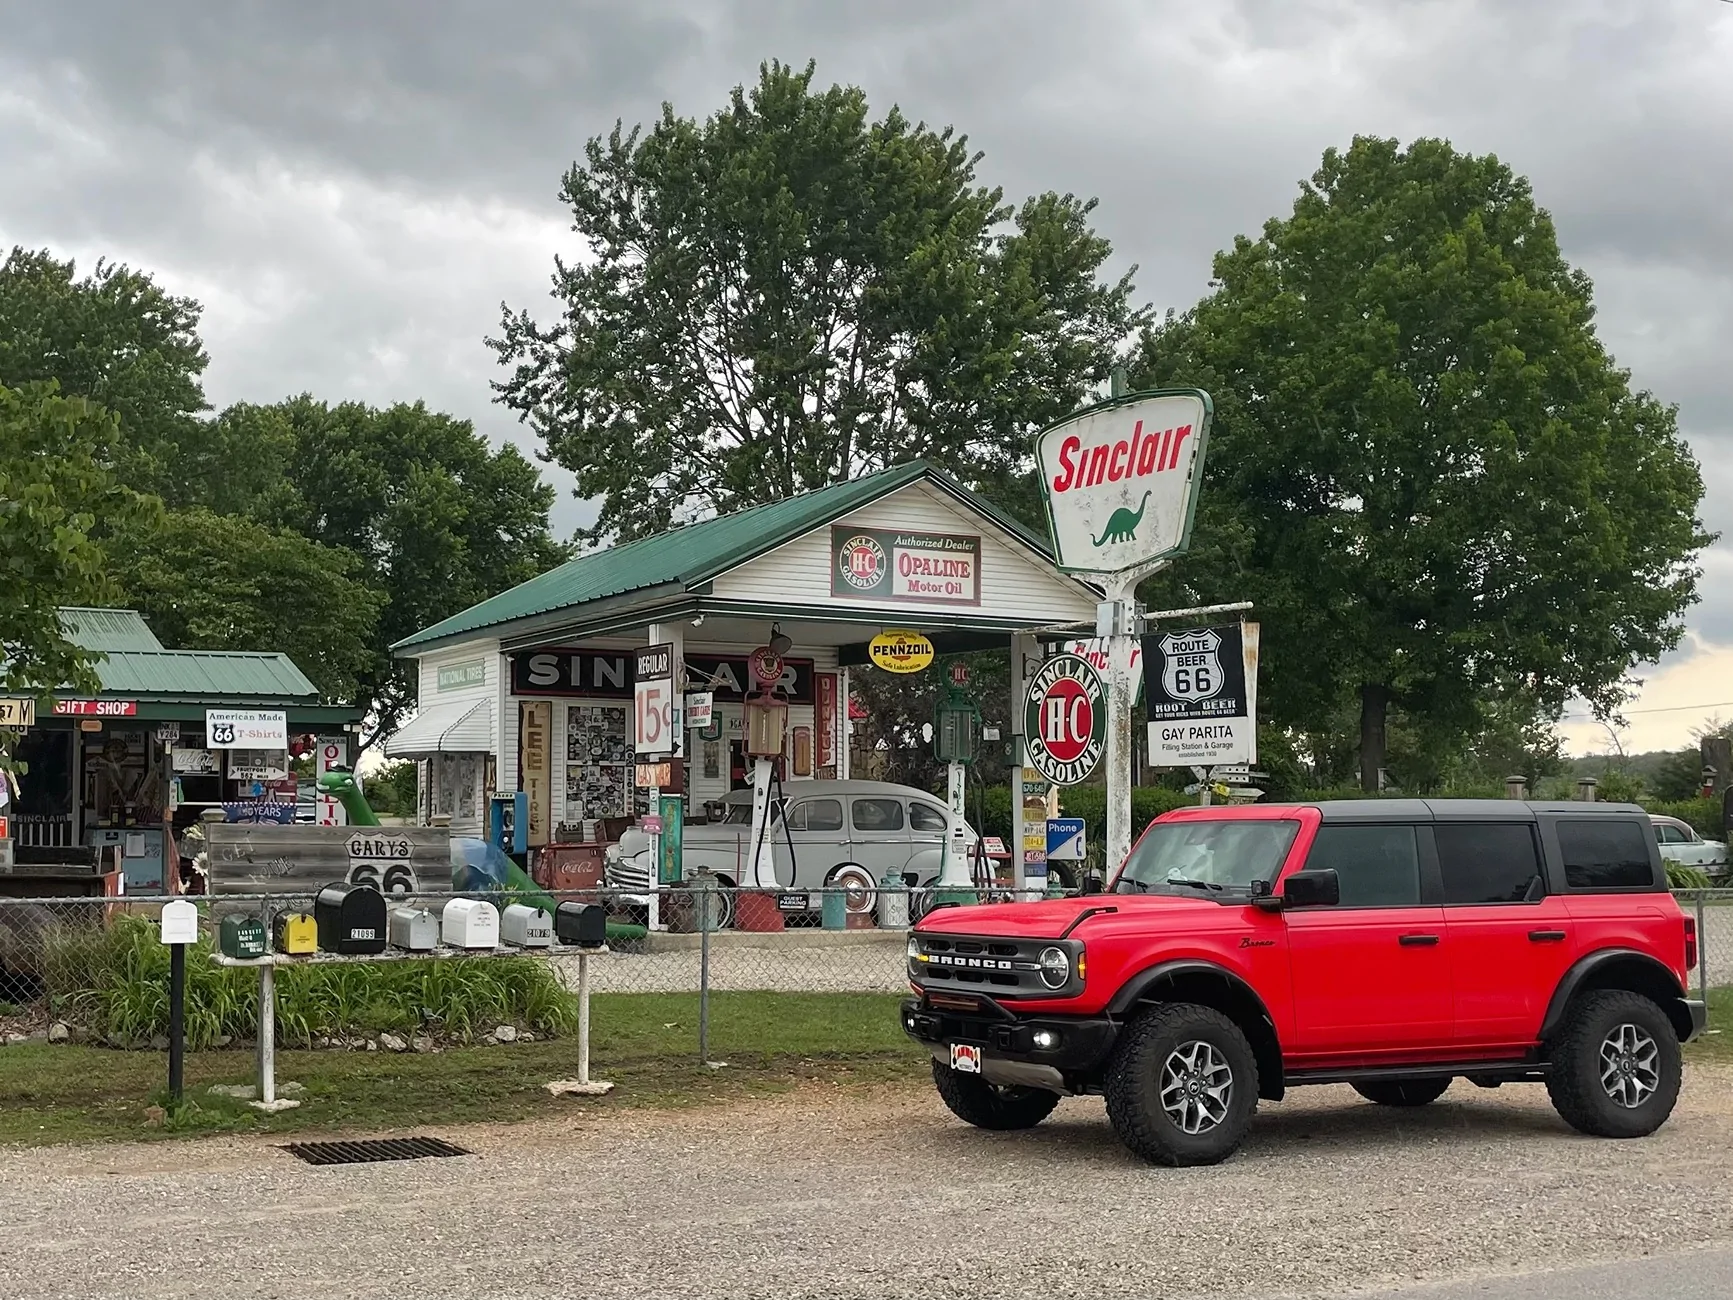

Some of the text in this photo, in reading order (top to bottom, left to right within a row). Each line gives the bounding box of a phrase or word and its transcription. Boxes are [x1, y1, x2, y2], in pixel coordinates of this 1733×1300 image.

[1053, 420, 1192, 493] Sinclair
[843, 537, 883, 560] SINCLAIR
[894, 535, 975, 551] Authorized Dealer
[899, 552, 971, 579] OPALINE
[842, 564, 884, 588] GASOLINE
[908, 579, 962, 595] Motor Oil
[873, 643, 932, 656] PENNZOIL
[1172, 640, 1210, 653] ROUTE
[638, 653, 668, 675] REGULAR
[882, 659, 922, 671] Safe Lubrication
[1177, 655, 1207, 668] BEER
[440, 665, 483, 686] NATIONAL TIRES
[1030, 659, 1100, 705] SINCLAIR
[1175, 667, 1212, 694] 66
[55, 700, 130, 715] GIFT SHOP
[1155, 699, 1236, 713] ROOT BEER
[208, 712, 284, 722] American Made
[214, 728, 283, 742] 66 T-Shirts
[527, 710, 543, 771] LEE
[1162, 725, 1234, 741] GAY PARITA
[1162, 741, 1234, 752] Filling Station & Garage
[1030, 737, 1101, 782] GASOLINE
[254, 806, 282, 818] YEARS
[528, 778, 540, 836] TIRES
[16, 814, 68, 822] SINCLAIR
[1048, 824, 1077, 833] Phone
[350, 840, 410, 858] GARYS
[350, 864, 414, 893] 66
[526, 928, 550, 938] 21079
[1238, 938, 1276, 949] Bronco
[928, 954, 1012, 970] BRONCO
